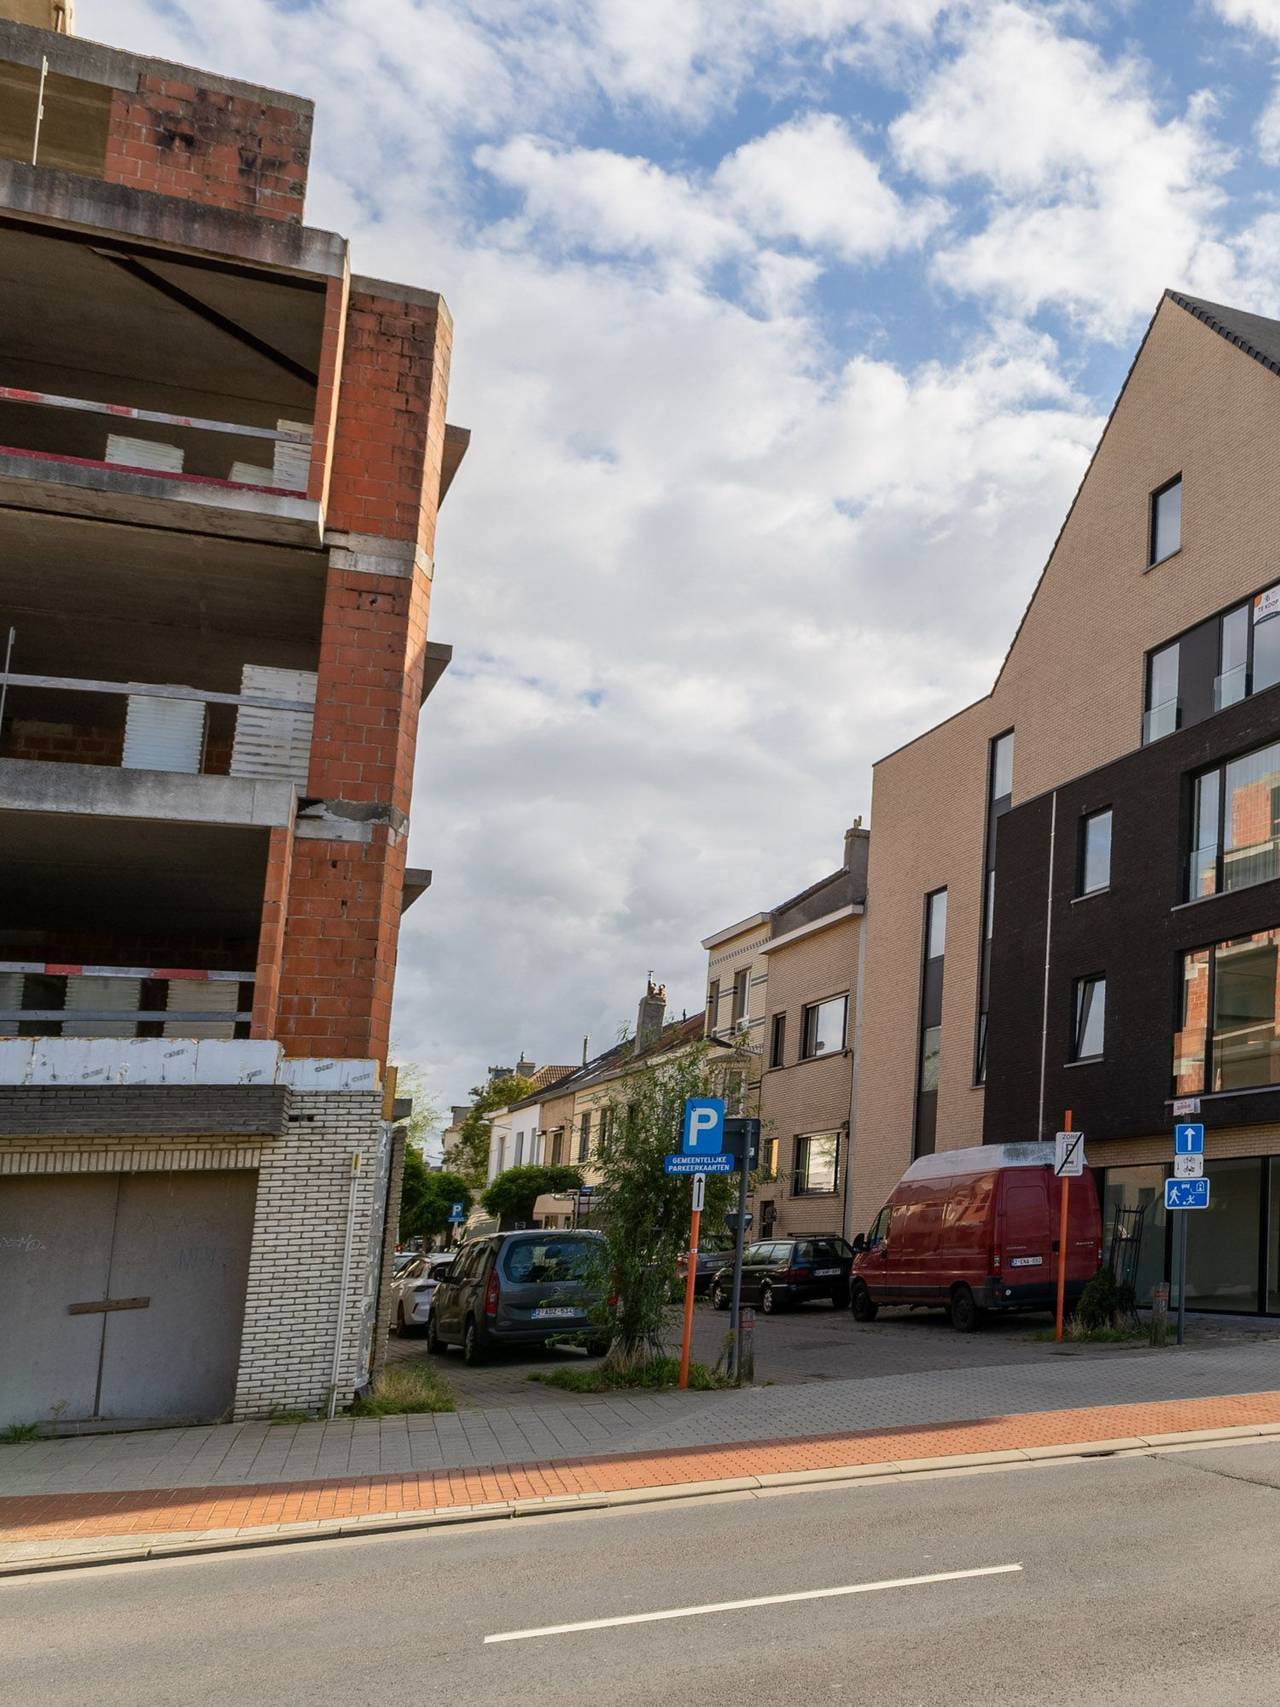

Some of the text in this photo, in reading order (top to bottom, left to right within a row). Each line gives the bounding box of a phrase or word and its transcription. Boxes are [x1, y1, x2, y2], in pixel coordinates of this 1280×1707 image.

[689, 1107, 719, 1147] P
[672, 1156, 727, 1164] GEMEENTELIJKE
[668, 1164, 730, 1172] PARKEERKAARTEN
[453, 1205, 462, 1216] P
